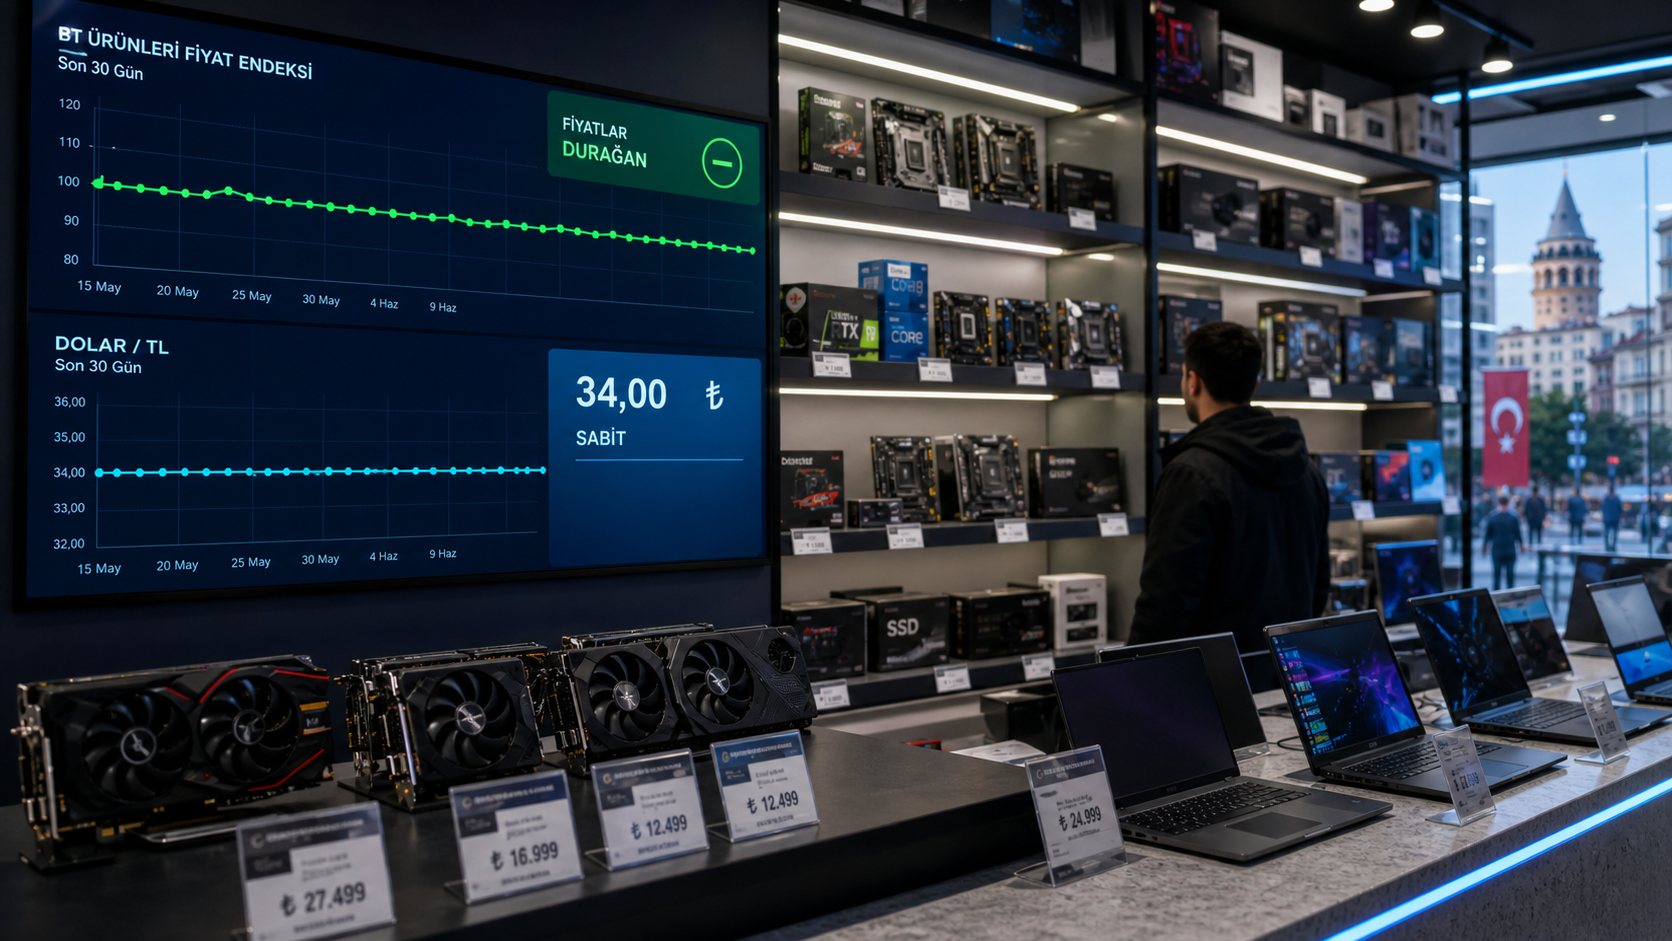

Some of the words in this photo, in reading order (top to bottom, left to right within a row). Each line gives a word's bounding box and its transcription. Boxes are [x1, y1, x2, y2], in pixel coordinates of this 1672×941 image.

[58, 25, 83, 43] BT
[87, 27, 180, 60] ÜRÜNLERİ
[185, 43, 234, 67] FİYAT
[238, 55, 313, 80] ENDEKSİ
[58, 56, 88, 73] Son
[91, 60, 110, 76] 30
[113, 63, 144, 81] Gün
[59, 98, 81, 111] 120
[562, 115, 628, 140] FİYATLAR
[59, 136, 81, 149] 110
[562, 139, 648, 168] DURAĞAN
[57, 175, 80, 188] 100
[63, 214, 80, 227] 90
[63, 253, 79, 266] 80
[77, 280, 93, 292] 15
[96, 281, 122, 295] May
[156, 284, 172, 297] 20
[174, 285, 200, 300] May
[232, 289, 246, 301] 25
[249, 290, 272, 304] May
[302, 293, 315, 305] 30
[316, 295, 341, 308] May
[370, 297, 378, 308] 4
[379, 299, 399, 310] Haz
[429, 301, 436, 312] 9
[438, 302, 457, 313] Haz
[55, 335, 127, 354] DOLAR
[132, 338, 141, 354] /
[146, 339, 170, 355] TL
[54, 358, 85, 372] Son
[89, 359, 108, 373] 30
[112, 360, 142, 374] Gün
[576, 375, 667, 414] 34,00
[705, 380, 724, 410] ₺
[54, 395, 86, 409] 36,00
[54, 431, 86, 445] 35,00
[576, 426, 627, 446] SABİT
[53, 466, 86, 480] 34,00
[53, 502, 86, 515] 33,00
[53, 537, 85, 551] 32,00
[301, 554, 316, 565] 30
[318, 553, 340, 566] May
[369, 551, 377, 562] 4
[379, 550, 398, 562] Haz
[429, 549, 436, 560] 9
[438, 548, 457, 560] Haz
[77, 563, 93, 575] 15
[96, 562, 122, 576] May
[156, 560, 174, 572] 20
[176, 559, 199, 573] May
[231, 557, 246, 568] 25
[248, 556, 271, 569] May
[887, 618, 919, 637] SSD
[761, 790, 799, 812] 12.499
[1070, 806, 1102, 829] 24.999
[646, 814, 688, 838] 12.499
[510, 841, 559, 868] 16.999
[304, 881, 366, 914] 27.499
